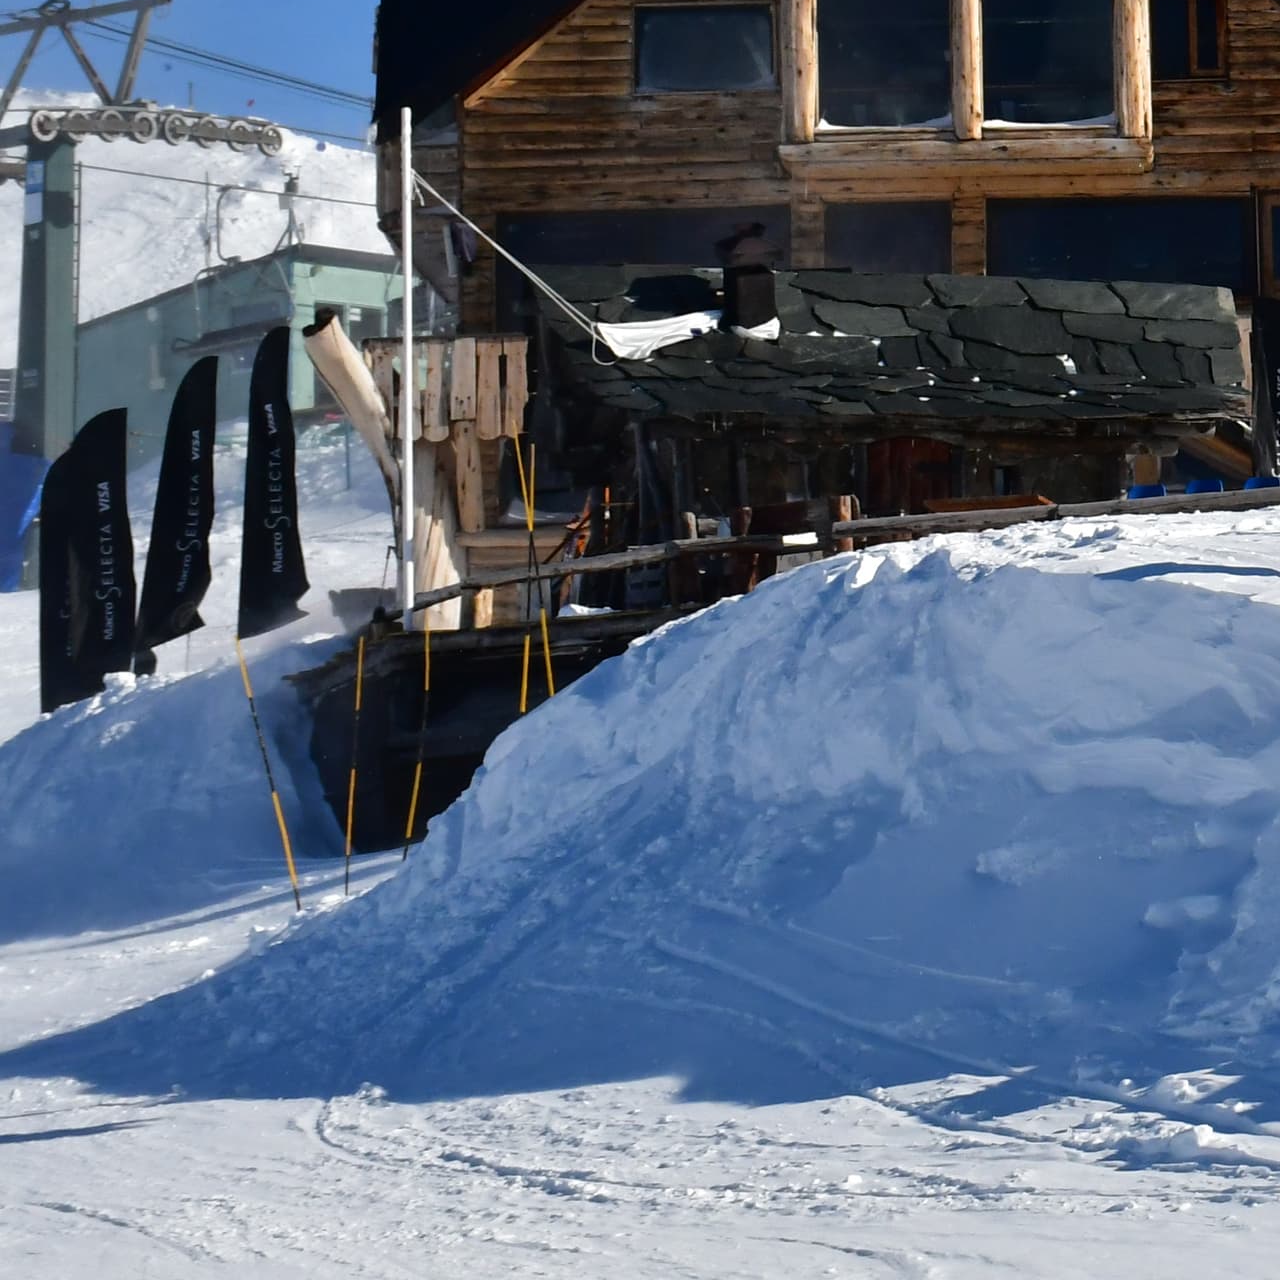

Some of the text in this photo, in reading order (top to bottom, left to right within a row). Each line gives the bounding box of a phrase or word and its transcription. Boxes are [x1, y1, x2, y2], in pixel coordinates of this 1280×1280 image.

[264, 403, 278, 435] VISA
[191, 429, 201, 461] VISA
[97, 481, 112, 512] VISA
